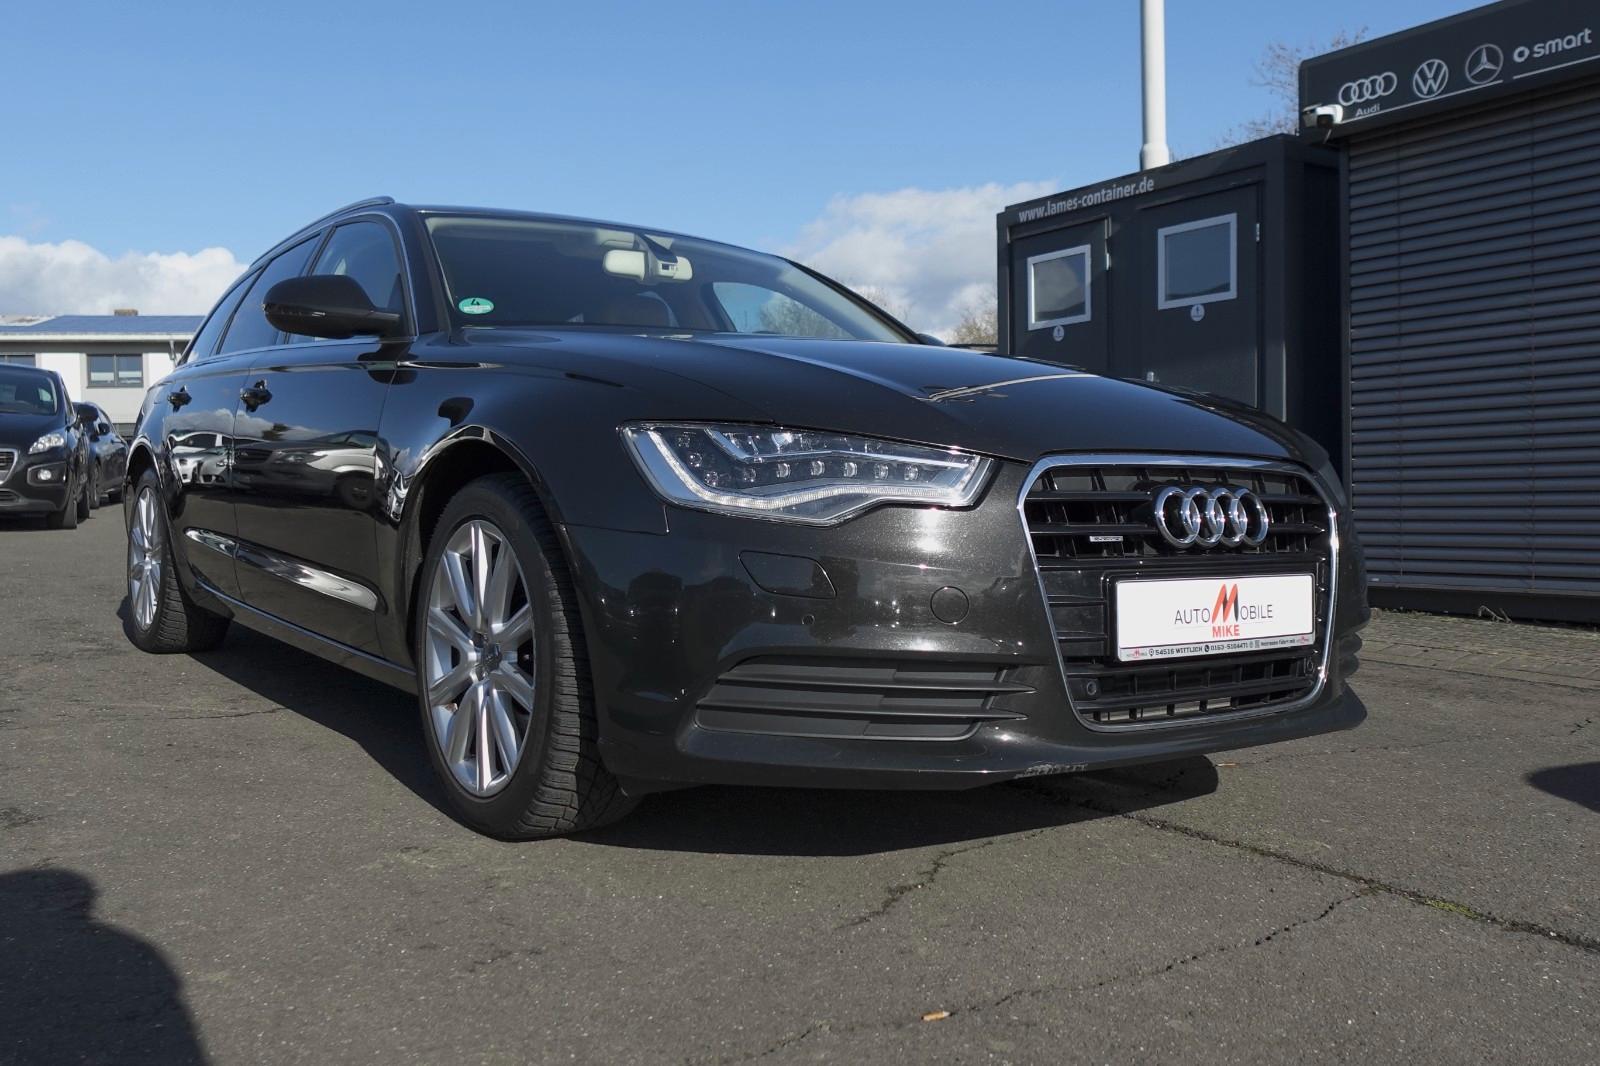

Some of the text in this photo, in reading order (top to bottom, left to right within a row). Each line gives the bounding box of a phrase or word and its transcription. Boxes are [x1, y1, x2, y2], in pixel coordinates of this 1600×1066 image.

[1532, 28, 1593, 58] smart
[1355, 104, 1381, 117] Audi
[1018, 176, 1155, 223] www.lames-container.de
[1212, 624, 1240, 638] MIKE
[1155, 648, 1175, 656] 54516
[1175, 646, 1203, 654] WITTLICH
